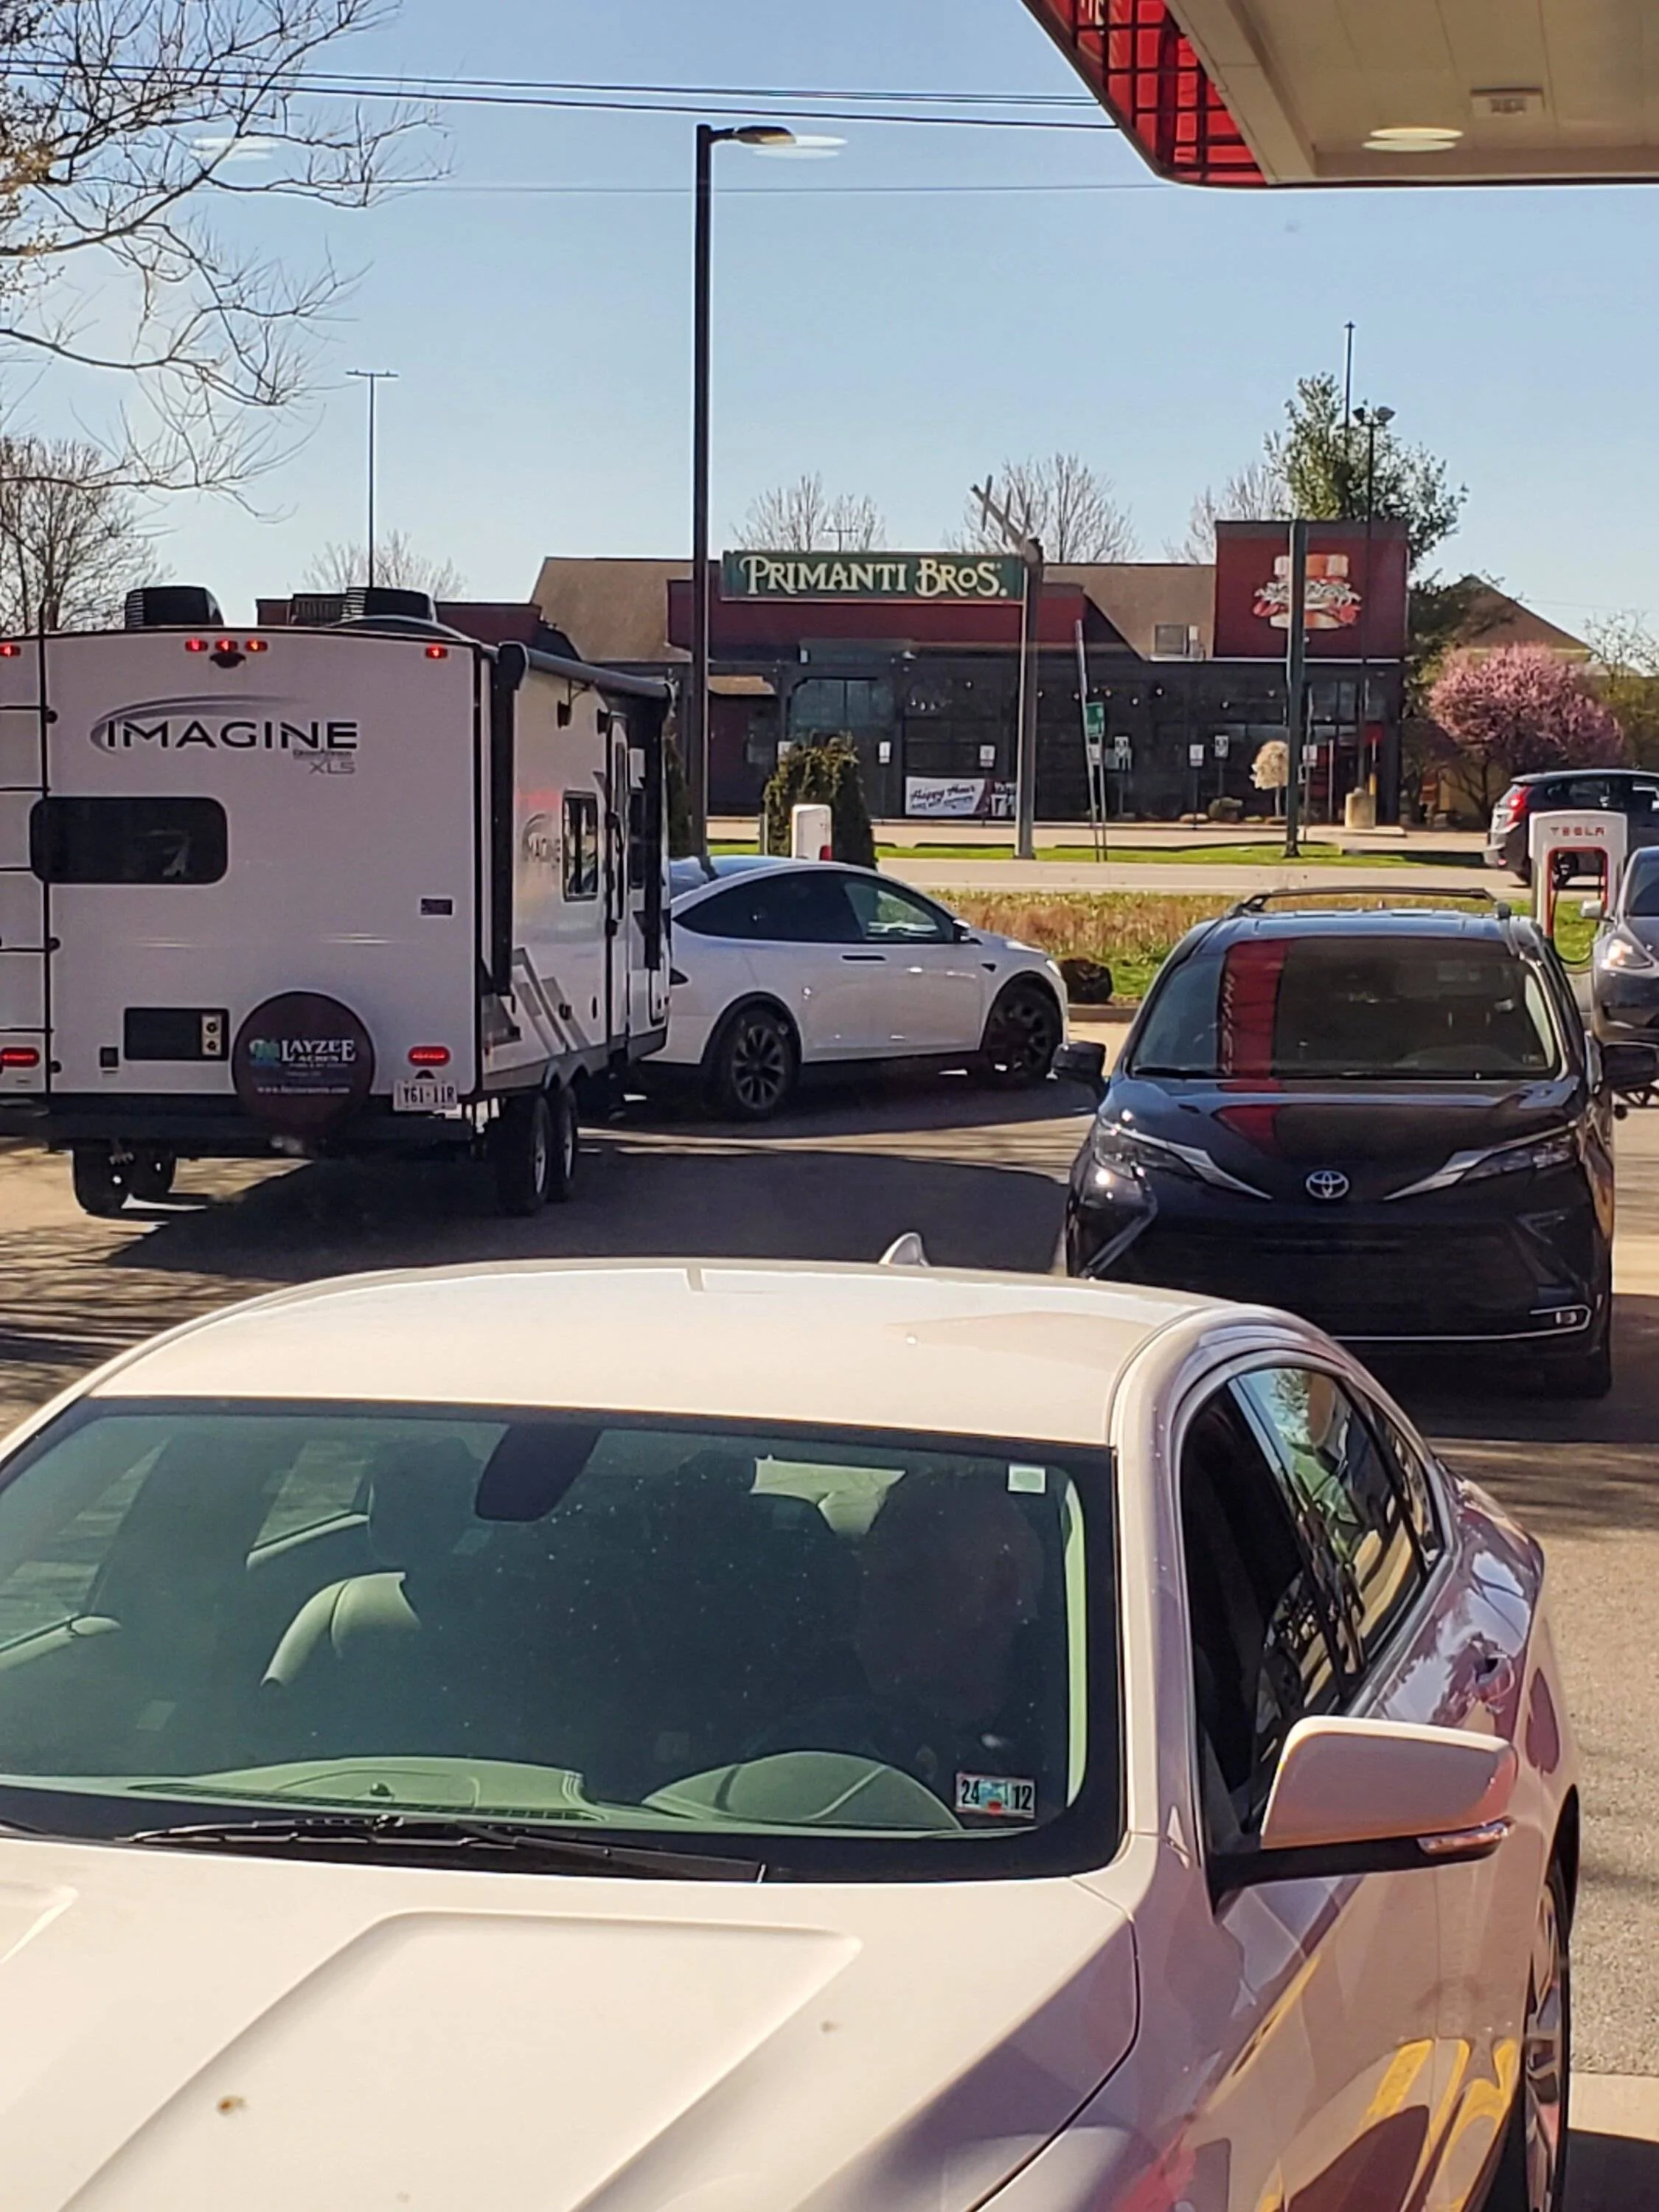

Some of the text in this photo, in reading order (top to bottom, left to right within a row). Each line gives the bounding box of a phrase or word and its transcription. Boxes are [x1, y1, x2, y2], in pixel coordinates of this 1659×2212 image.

[739, 555, 906, 595] PRIMANTI
[108, 720, 358, 749] IMAGINE
[310, 761, 356, 775] XLS
[1550, 827, 1604, 837] TESLA
[282, 1040, 357, 1062] LAYZEE
[961, 1778, 1032, 1811] 24 12
